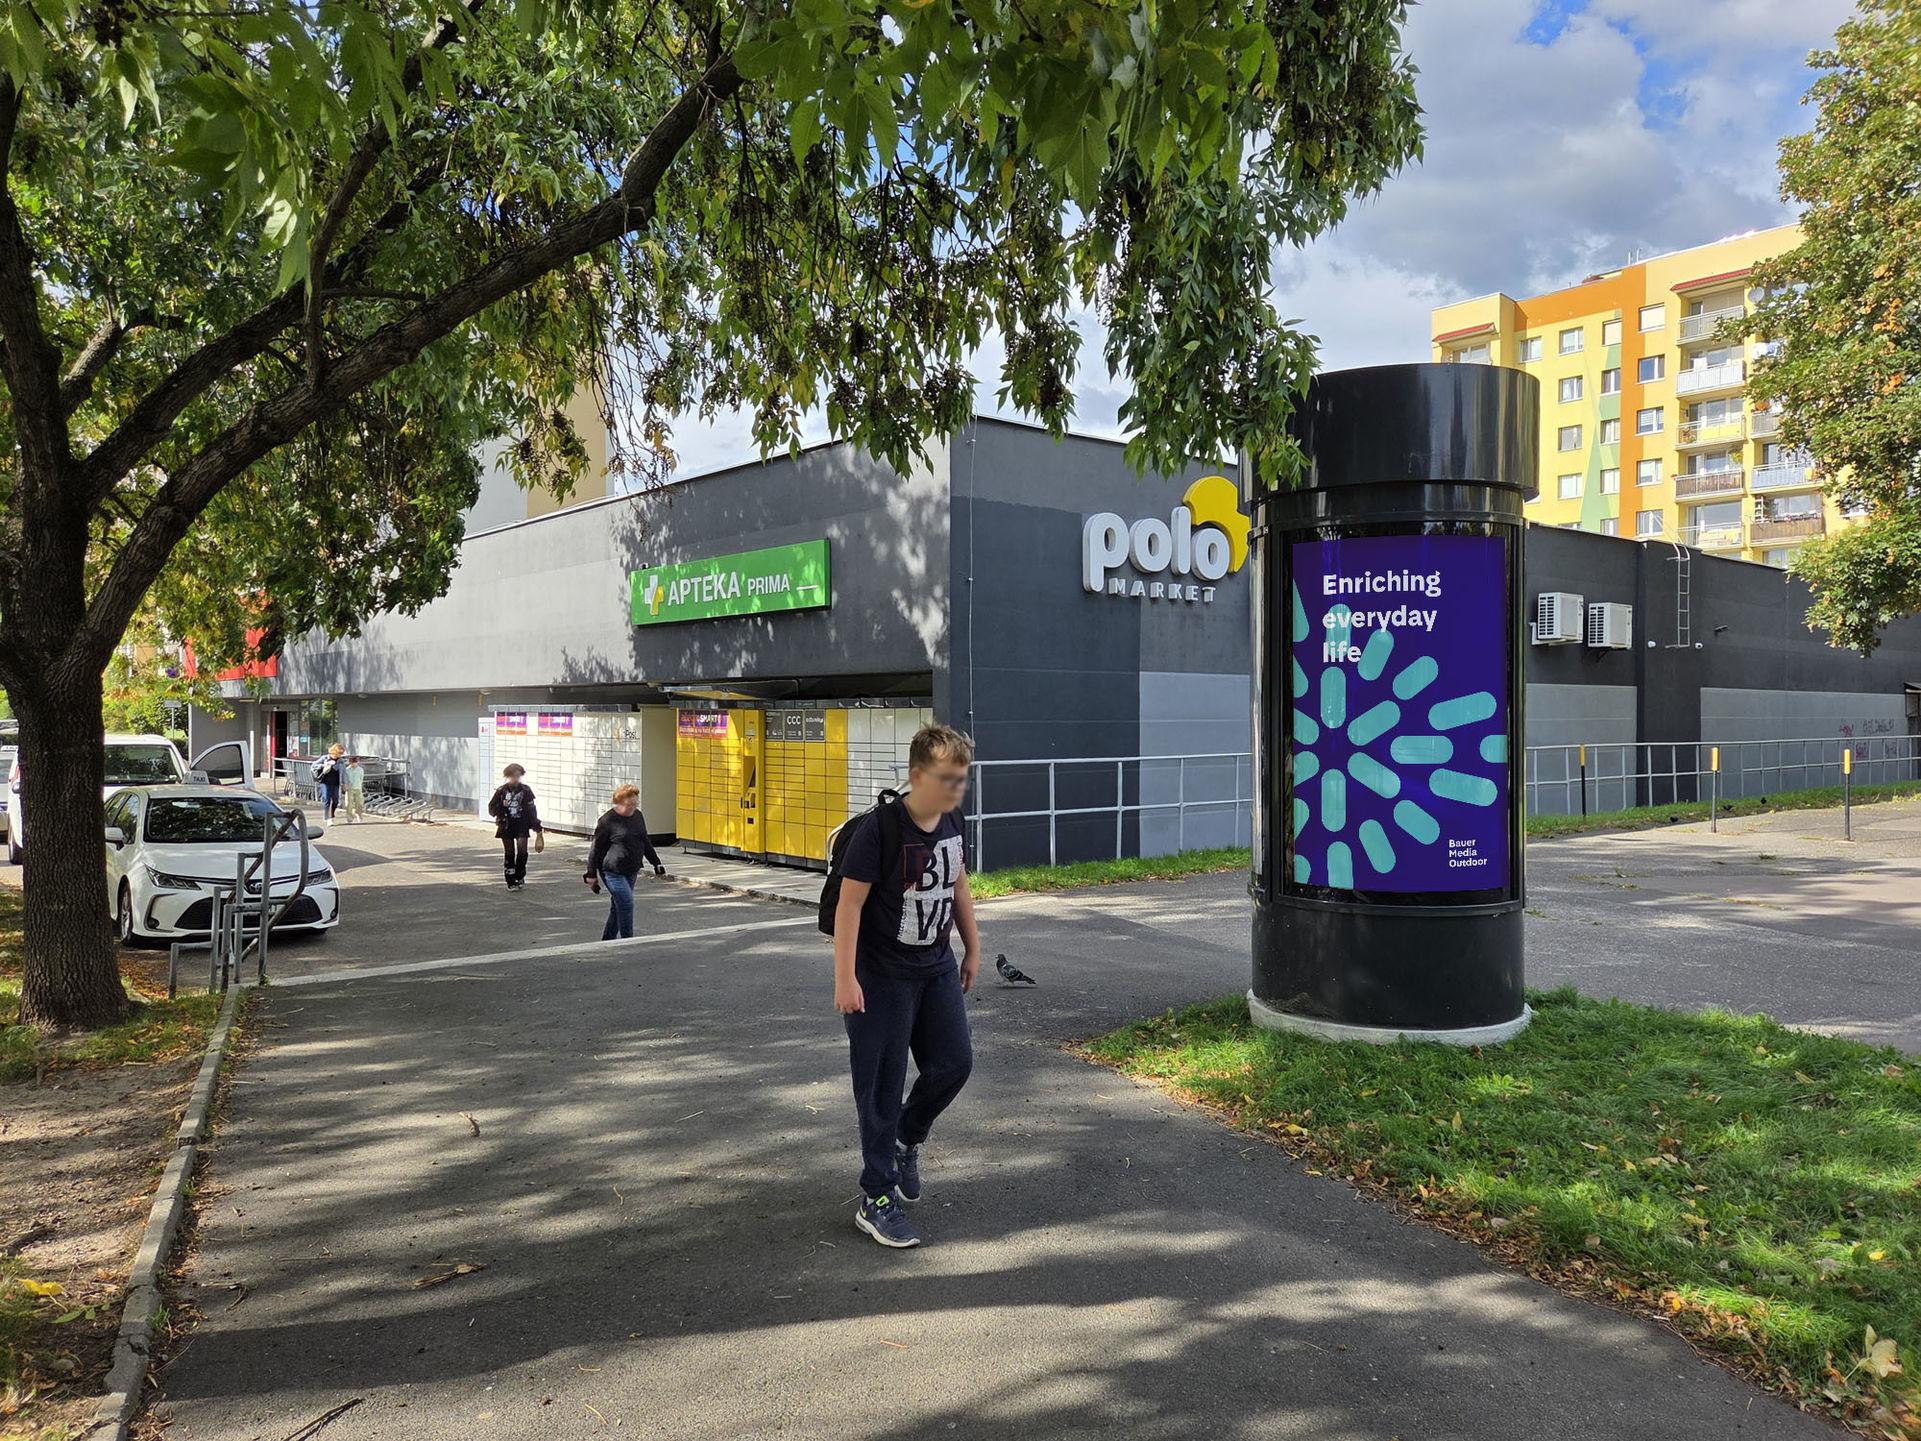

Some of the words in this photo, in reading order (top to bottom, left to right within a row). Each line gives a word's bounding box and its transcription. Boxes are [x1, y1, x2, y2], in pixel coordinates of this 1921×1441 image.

[1083, 506, 1230, 592] polo
[667, 571, 741, 606] APTEKA
[748, 573, 790, 596] PRIMA
[1108, 578, 1217, 603] MARKET
[1323, 570, 1441, 597] Enriching
[1322, 605, 1437, 632] everyday
[1322, 642, 1362, 664] life
[786, 715, 801, 725] CCC
[1449, 839, 1476, 848] Bauer
[1449, 848, 1477, 857] Media
[1449, 858, 1487, 867] Outdoor
